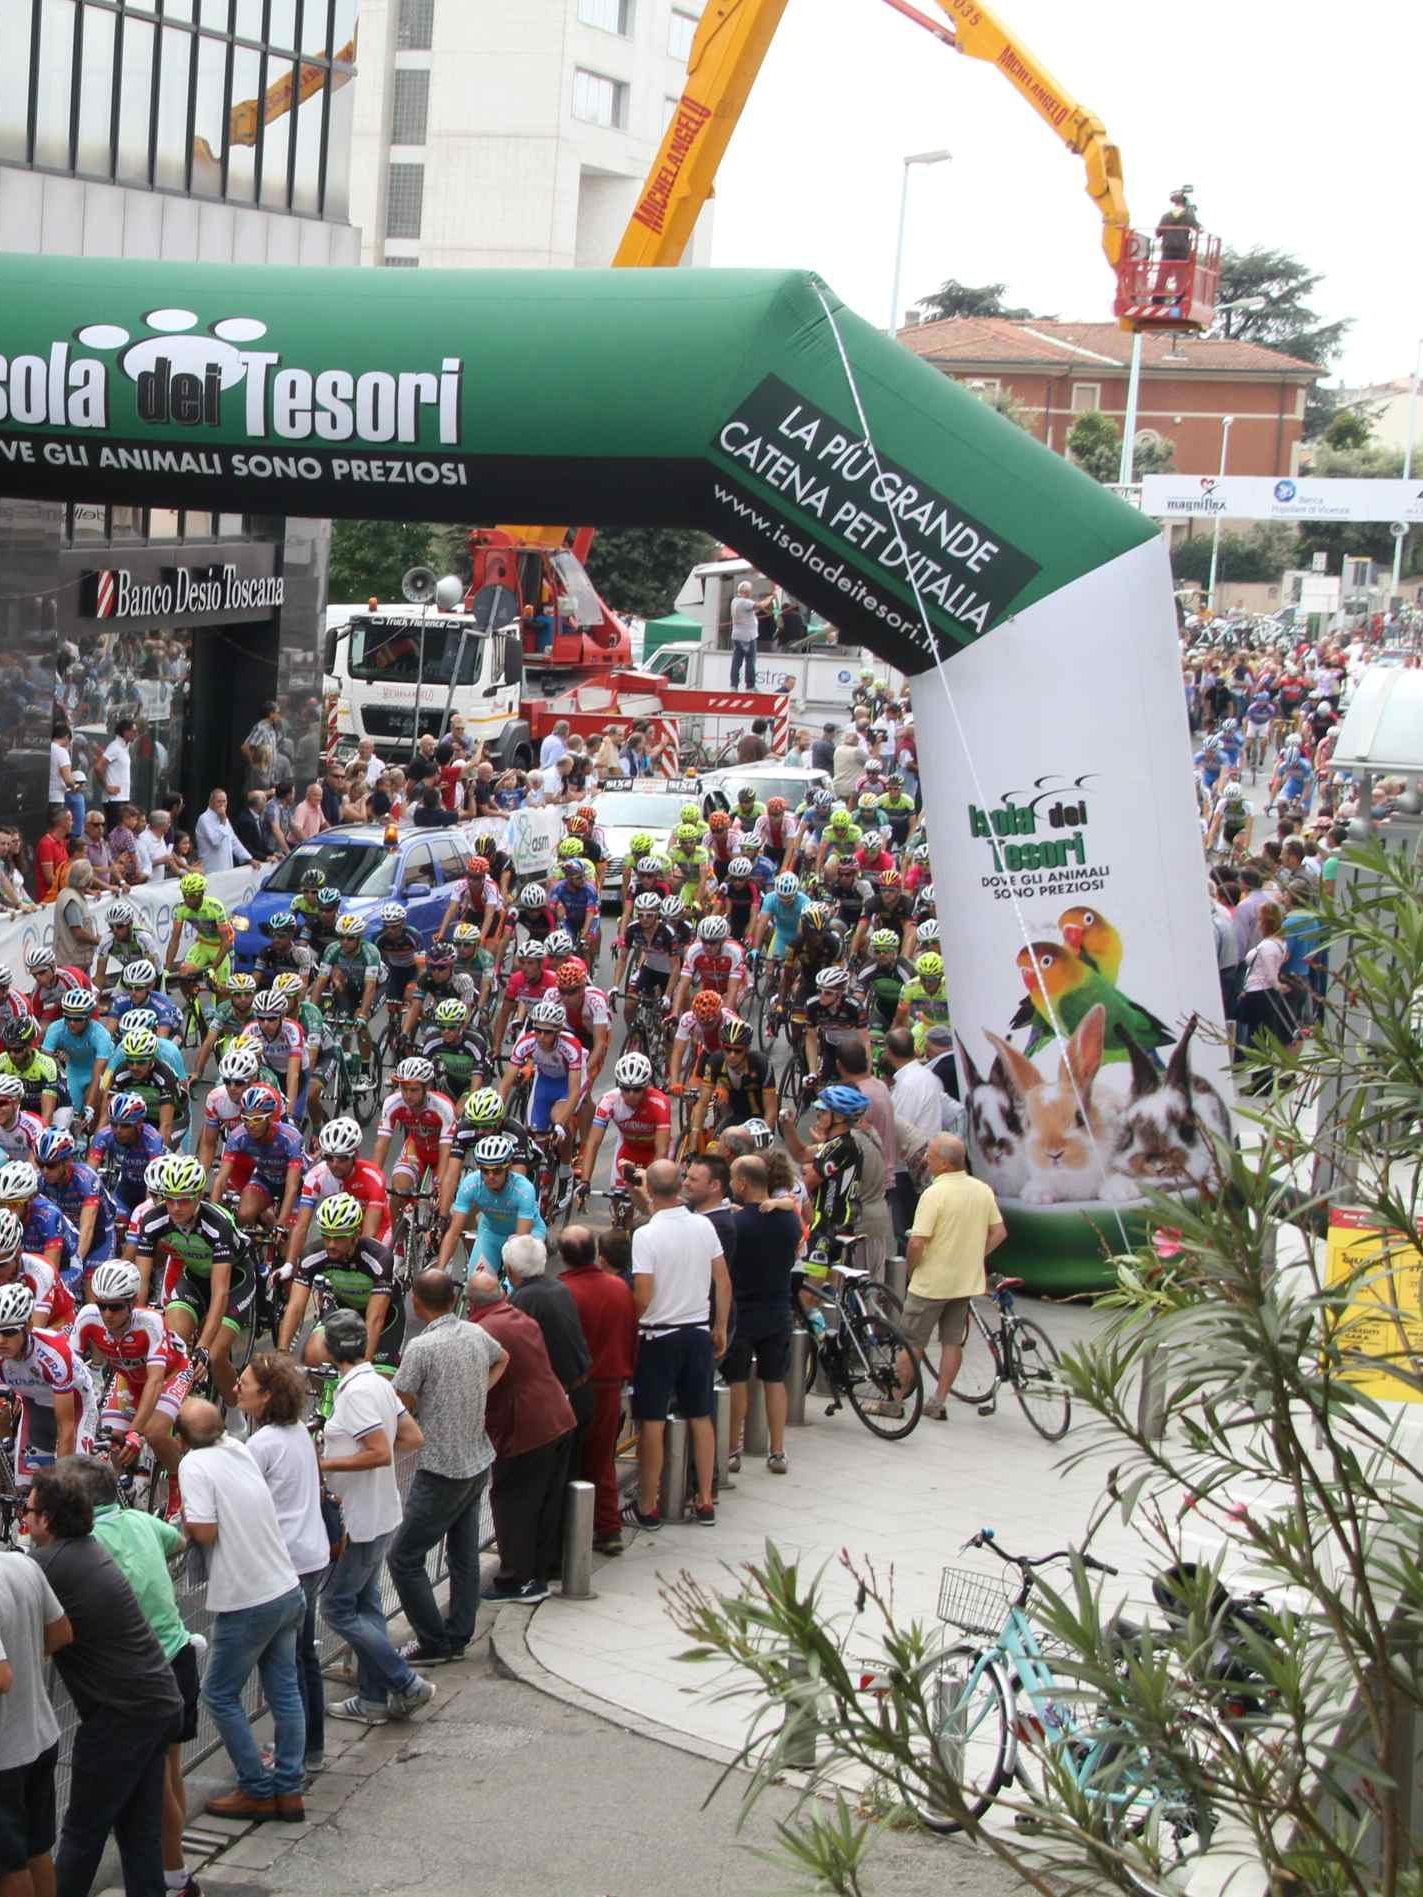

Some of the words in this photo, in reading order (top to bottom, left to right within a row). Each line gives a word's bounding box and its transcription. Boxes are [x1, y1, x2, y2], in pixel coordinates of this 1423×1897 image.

[998, 45, 1069, 126] MICHELANGELO
[632, 95, 712, 235] MICHELANGELO
[136, 356, 222, 426] dei
[239, 352, 462, 445] Tesori
[43, 441, 89, 467] GLI
[99, 447, 222, 475] ANIMALI
[233, 455, 323, 480] SONO
[333, 459, 468, 485] PREZIOSI
[720, 422, 830, 518] CATENA
[829, 501, 887, 549] PET
[778, 405, 821, 451] LA
[869, 472, 999, 573] GRANDE
[116, 569, 172, 617] Banco
[175, 567, 222, 613] Desio
[223, 564, 285, 609] Toscana
[714, 484, 940, 654] www.isoladeitesori.it
[1048, 800, 1088, 829] dei
[981, 873, 1017, 888] DOVE
[1021, 870, 1044, 885] GLI
[1047, 865, 1110, 883] ANIMALI
[987, 831, 1086, 873] Tesori
[994, 883, 1035, 900] SONO
[1039, 878, 1105, 898] PREZIOSI
